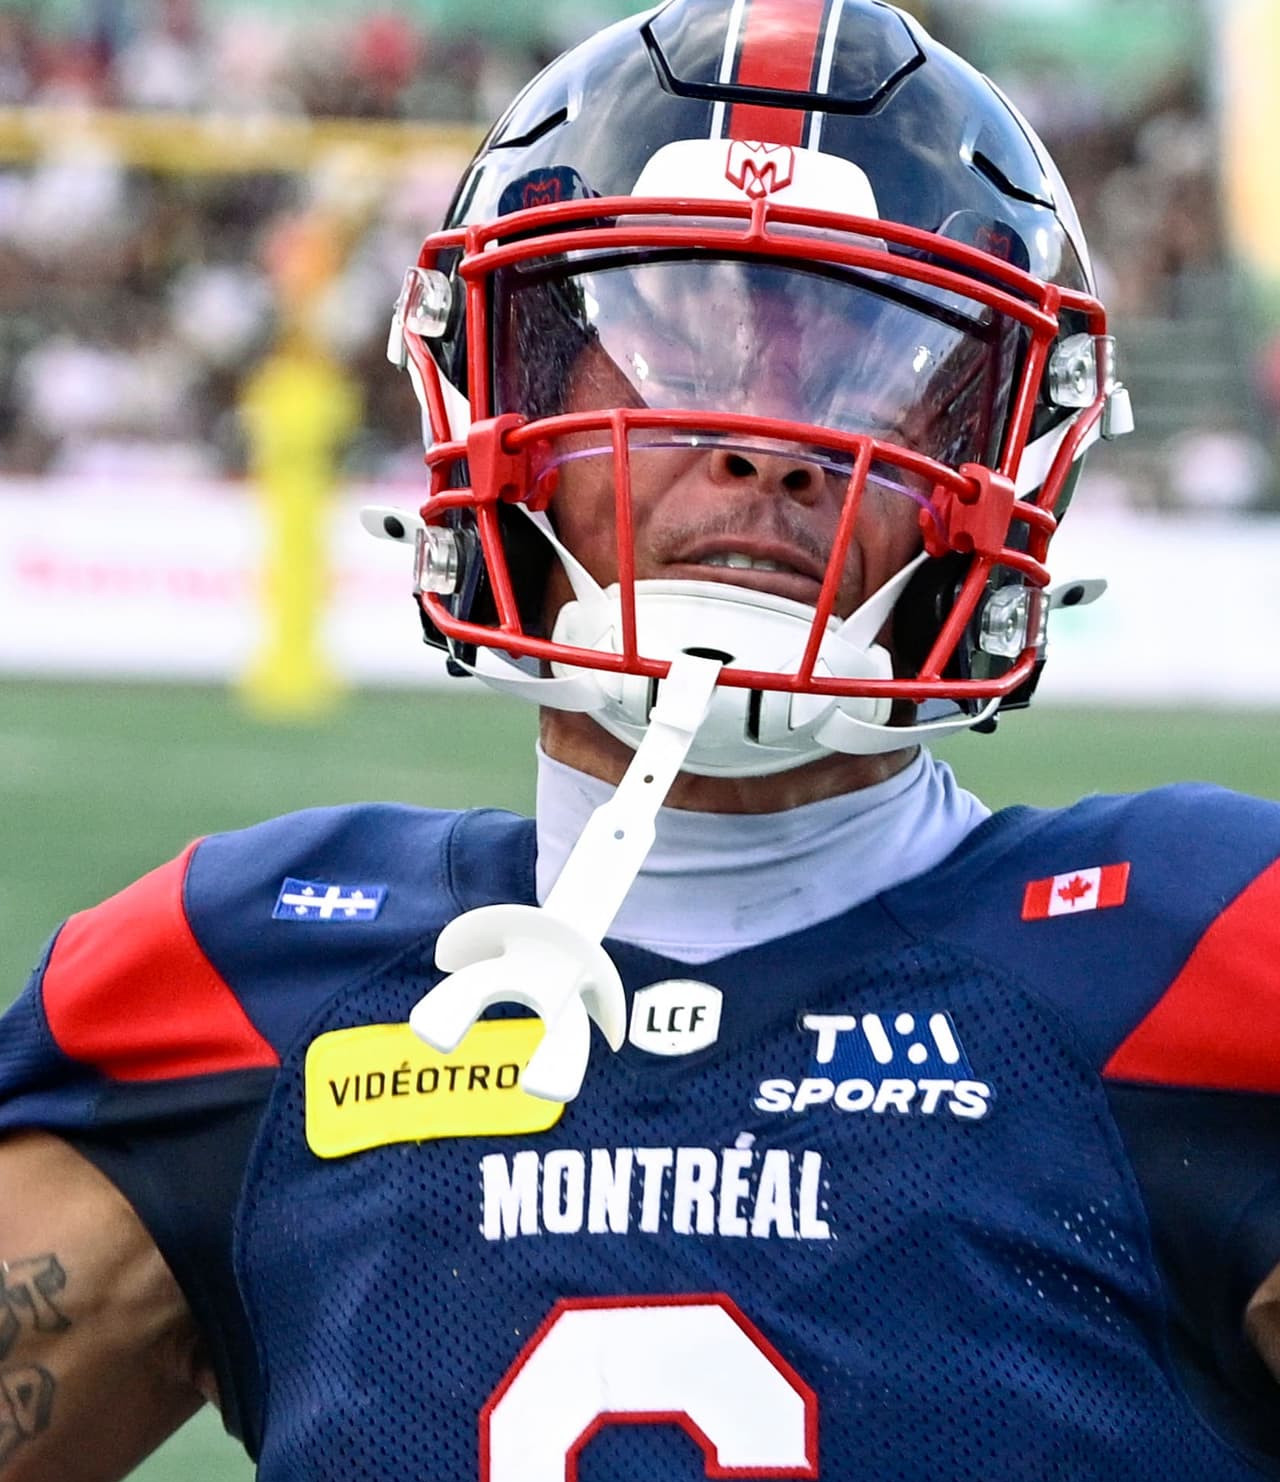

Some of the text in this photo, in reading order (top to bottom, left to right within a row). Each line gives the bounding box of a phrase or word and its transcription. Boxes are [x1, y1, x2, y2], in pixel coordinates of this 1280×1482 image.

[646, 1005, 707, 1033] LCF
[329, 1061, 533, 1107] VIDÉOTRO
[754, 1077, 992, 1120] SPORTS
[480, 1131, 834, 1240] MONTRÉAL
